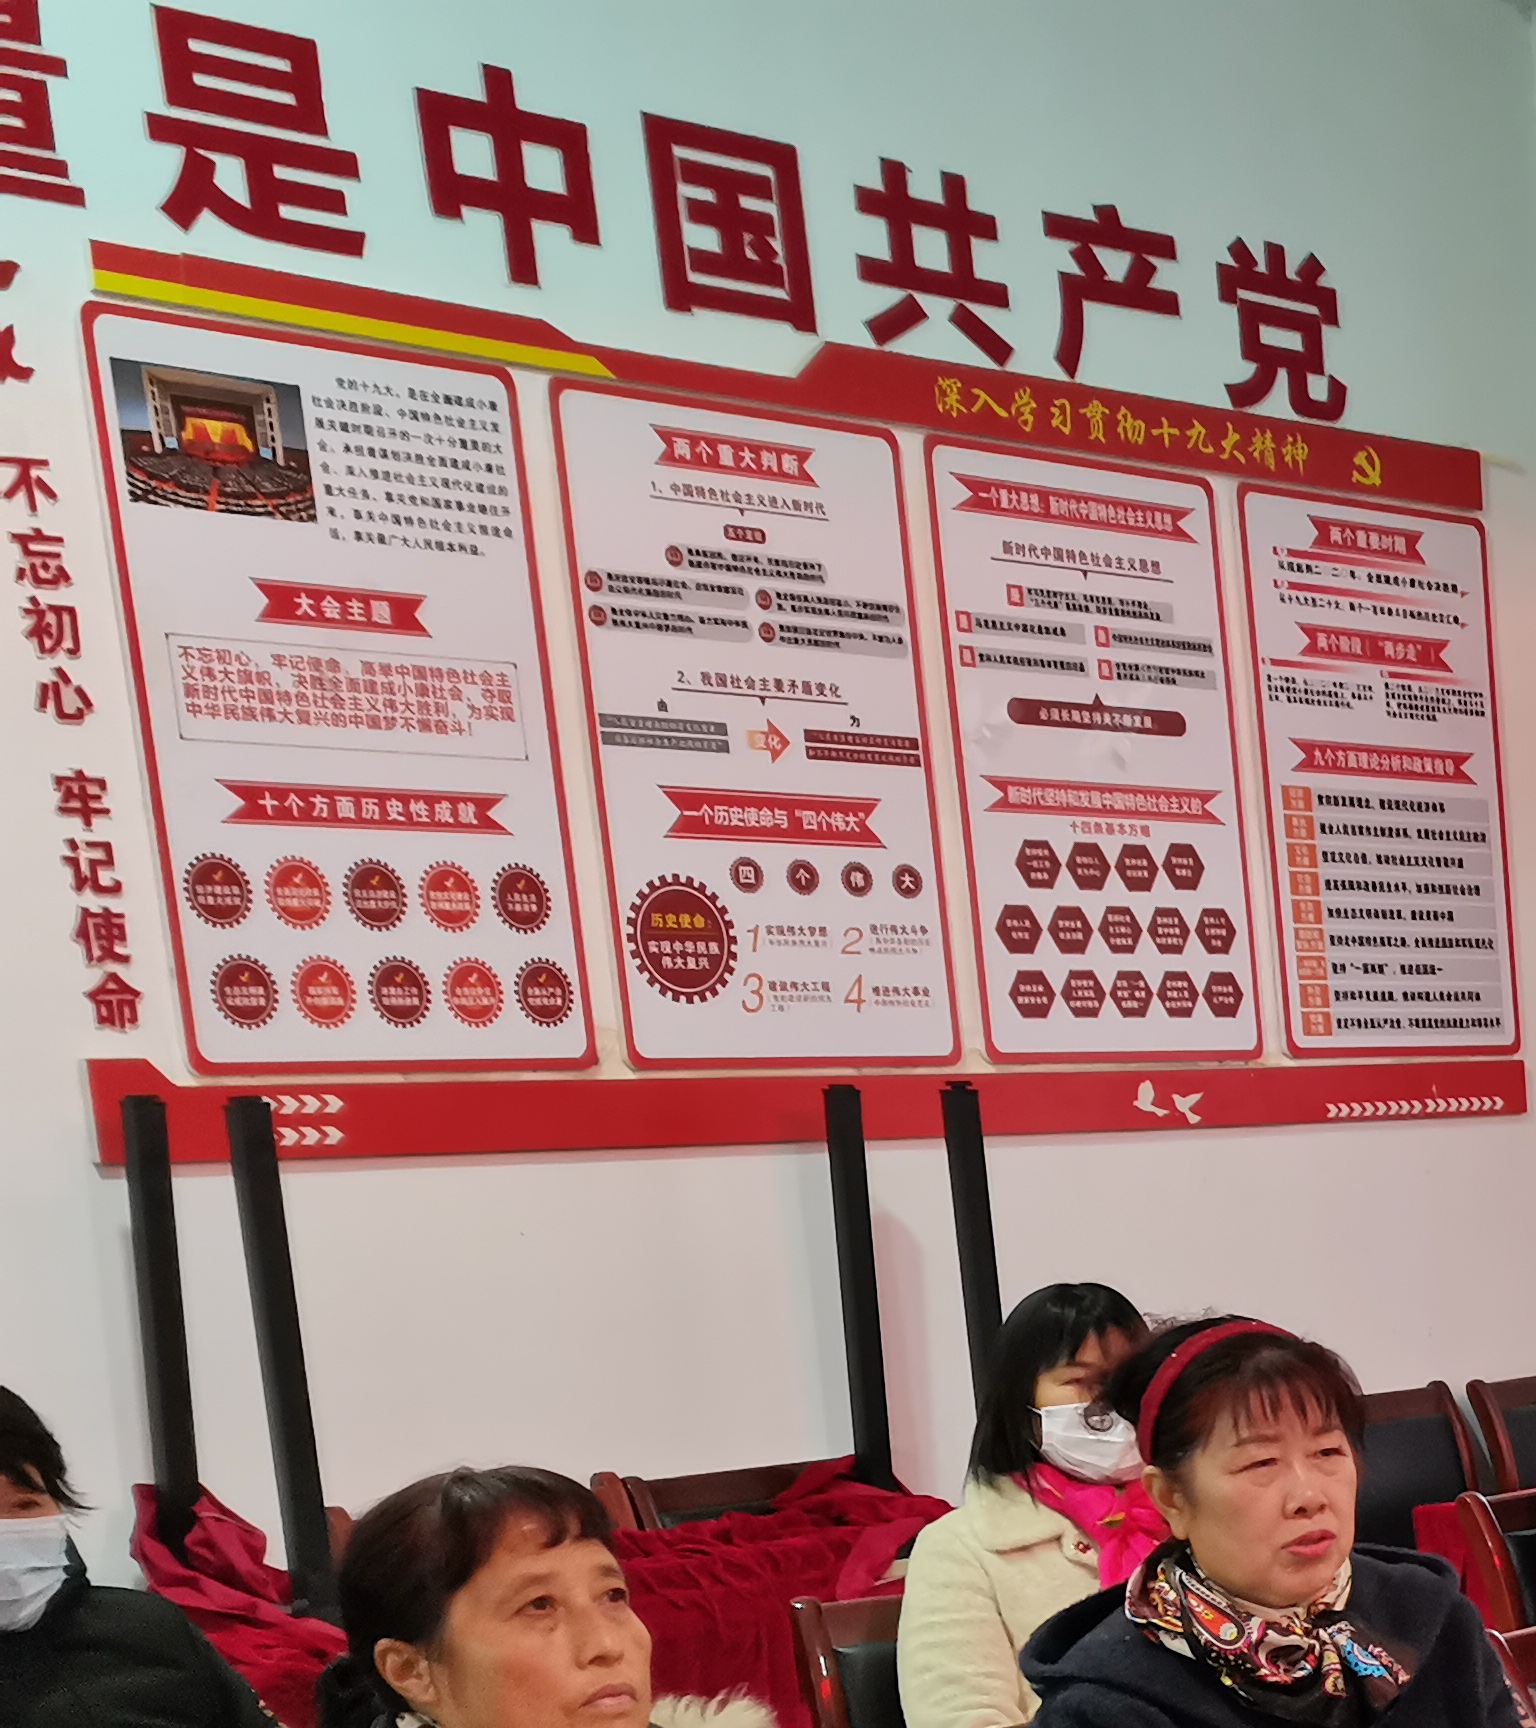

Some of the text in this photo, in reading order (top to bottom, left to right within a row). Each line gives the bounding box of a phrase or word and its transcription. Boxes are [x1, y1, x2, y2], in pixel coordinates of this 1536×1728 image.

[933, 375, 1311, 475] 深入学习贯彻十九大精神
[672, 436, 800, 477] 两个重大判断
[1329, 524, 1407, 556] 两个重要时期
[1002, 540, 1163, 576] 新时代中国特色社会主义思想
[293, 593, 392, 625] 大会主题
[0, 454, 145, 1034] 不忘初心 牢记使命
[257, 790, 479, 825] 十个方面历史性成就
[646, 940, 721, 955] 实现中华民族
[746, 924, 760, 953] 1
[840, 926, 864, 955] 2
[661, 955, 711, 970] 伟大复兴
[741, 972, 765, 1014] 3
[843, 973, 867, 1013] 4
